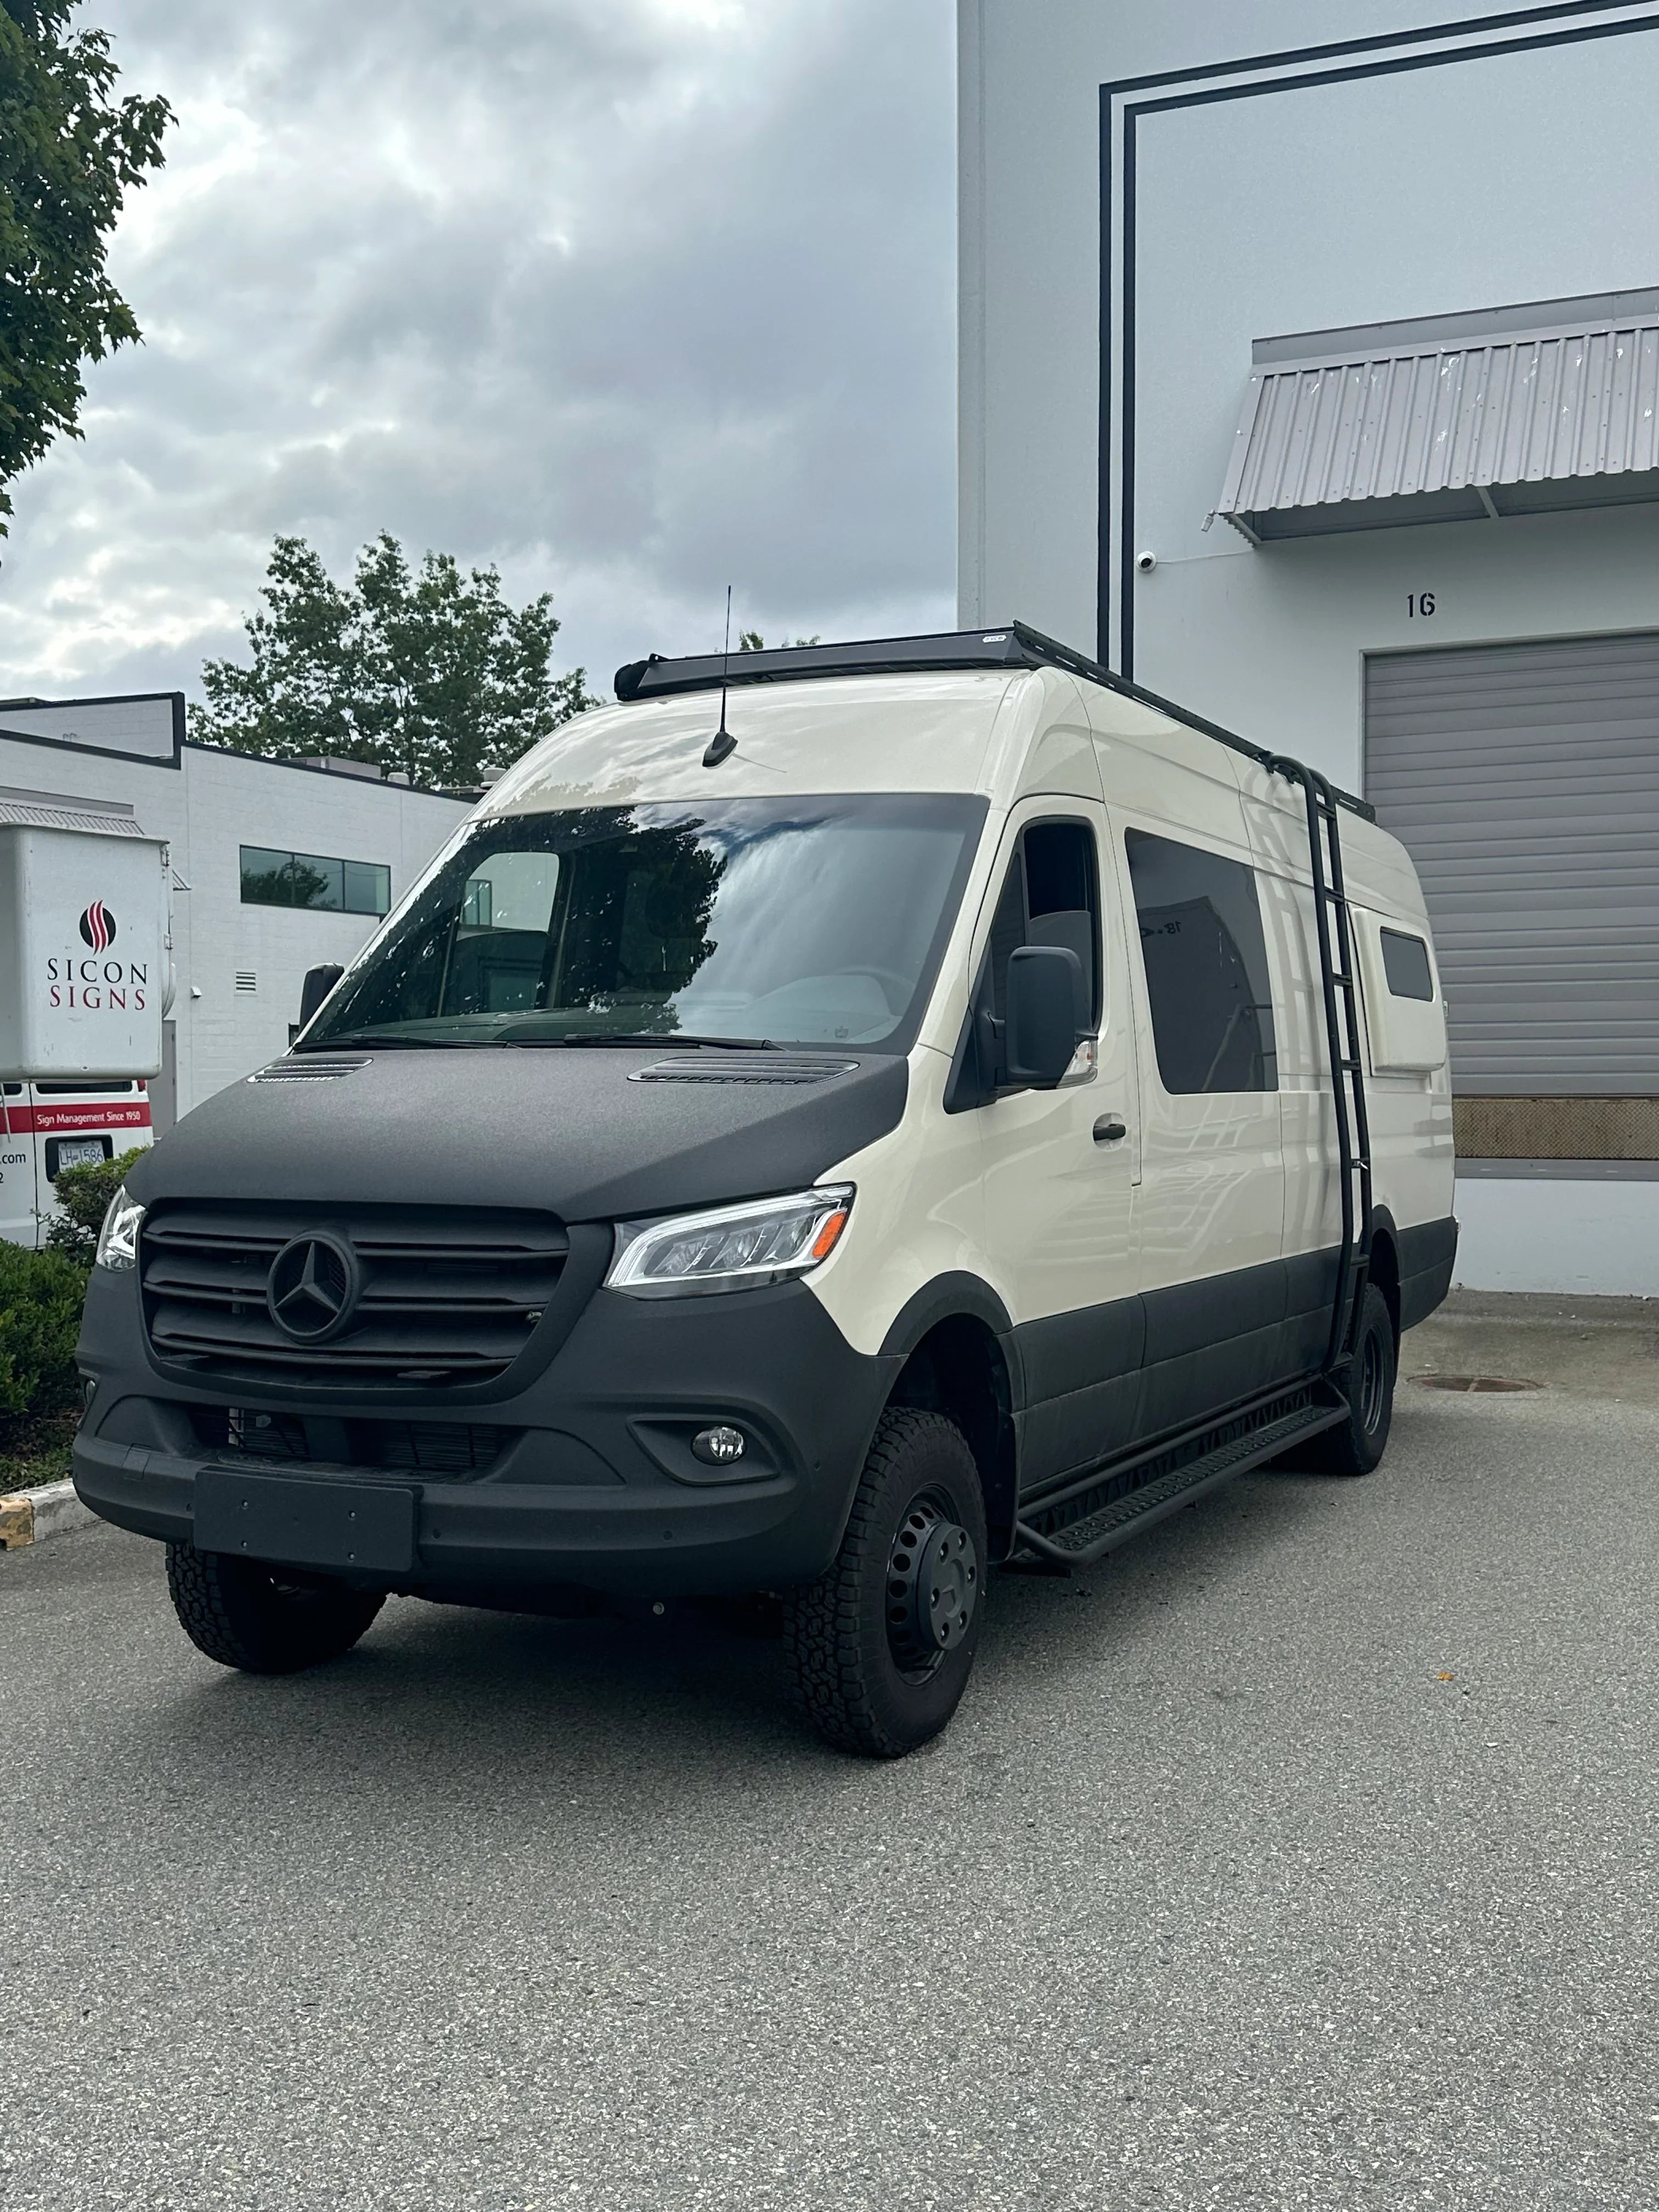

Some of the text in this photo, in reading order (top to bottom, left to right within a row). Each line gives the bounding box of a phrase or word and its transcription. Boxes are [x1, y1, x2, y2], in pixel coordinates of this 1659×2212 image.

[1407, 592, 1435, 618] 16
[47, 958, 148, 985] SICON
[49, 985, 145, 1011] SIGNS
[37, 1110, 140, 1126] Sign Management Since 1950
